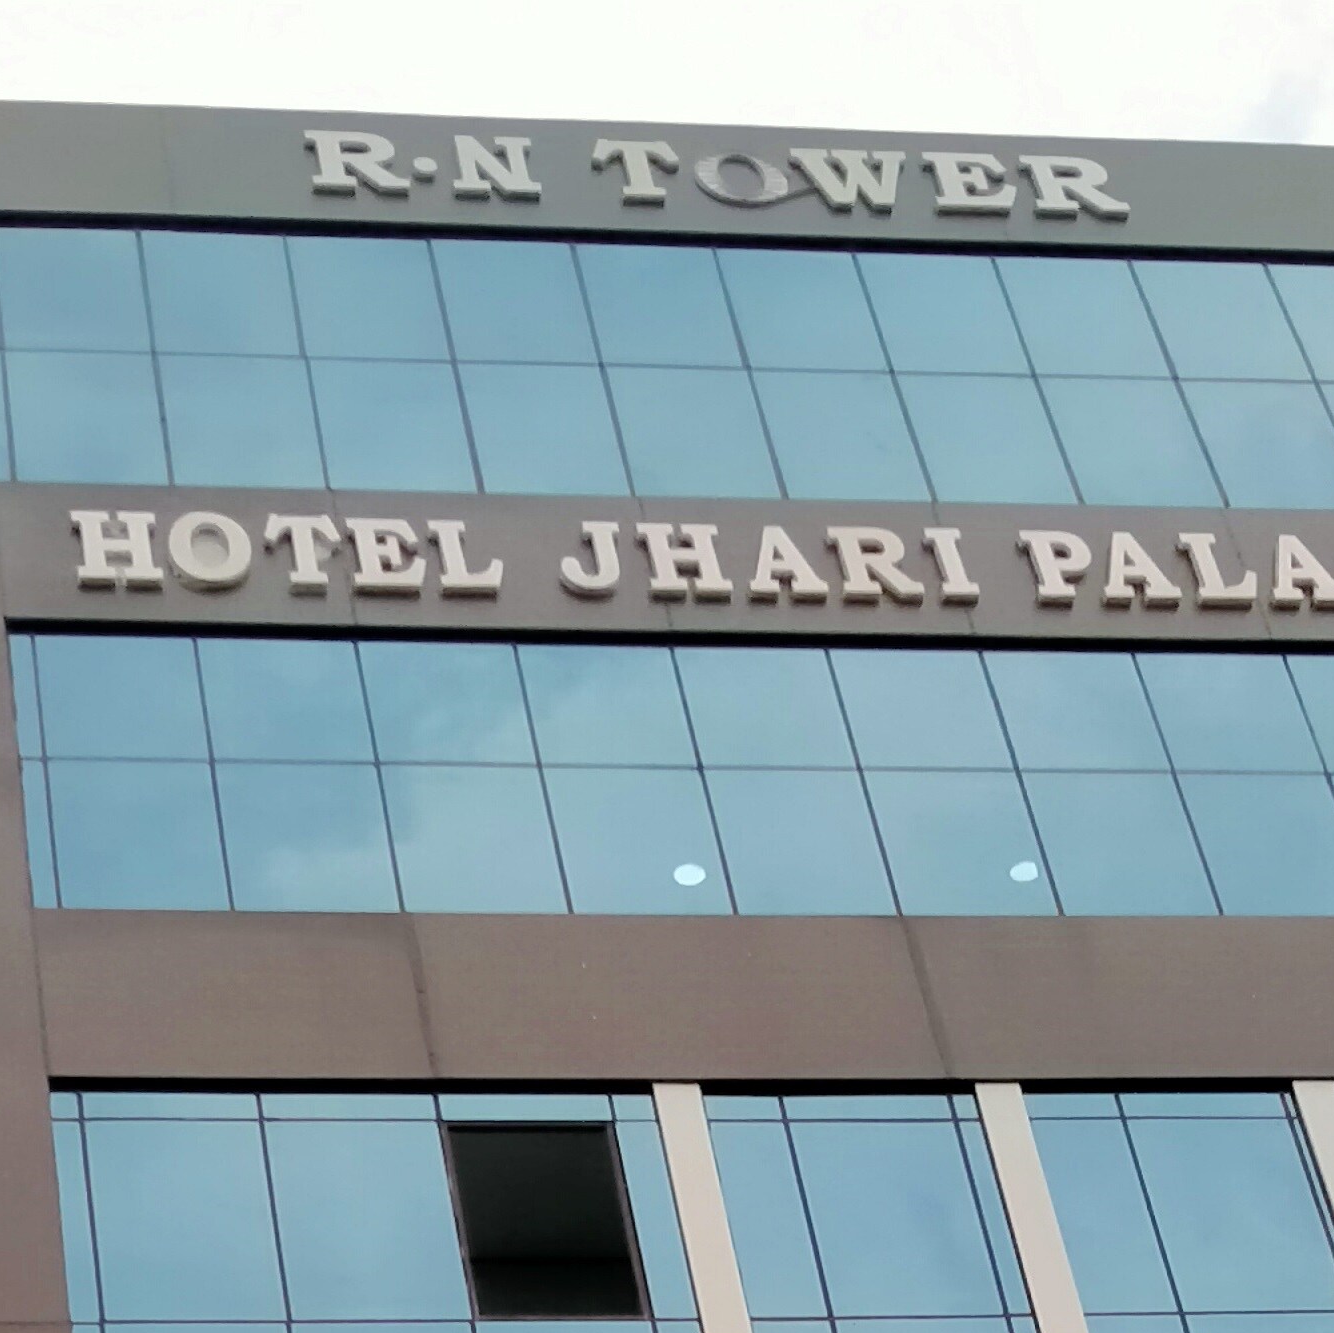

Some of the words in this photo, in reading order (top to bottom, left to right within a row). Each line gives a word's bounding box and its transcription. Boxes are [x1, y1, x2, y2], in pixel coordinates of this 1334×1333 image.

[591, 138, 1131, 222] TOWER
[70, 509, 505, 597] HOTEL
[560, 520, 979, 607] JHARI
